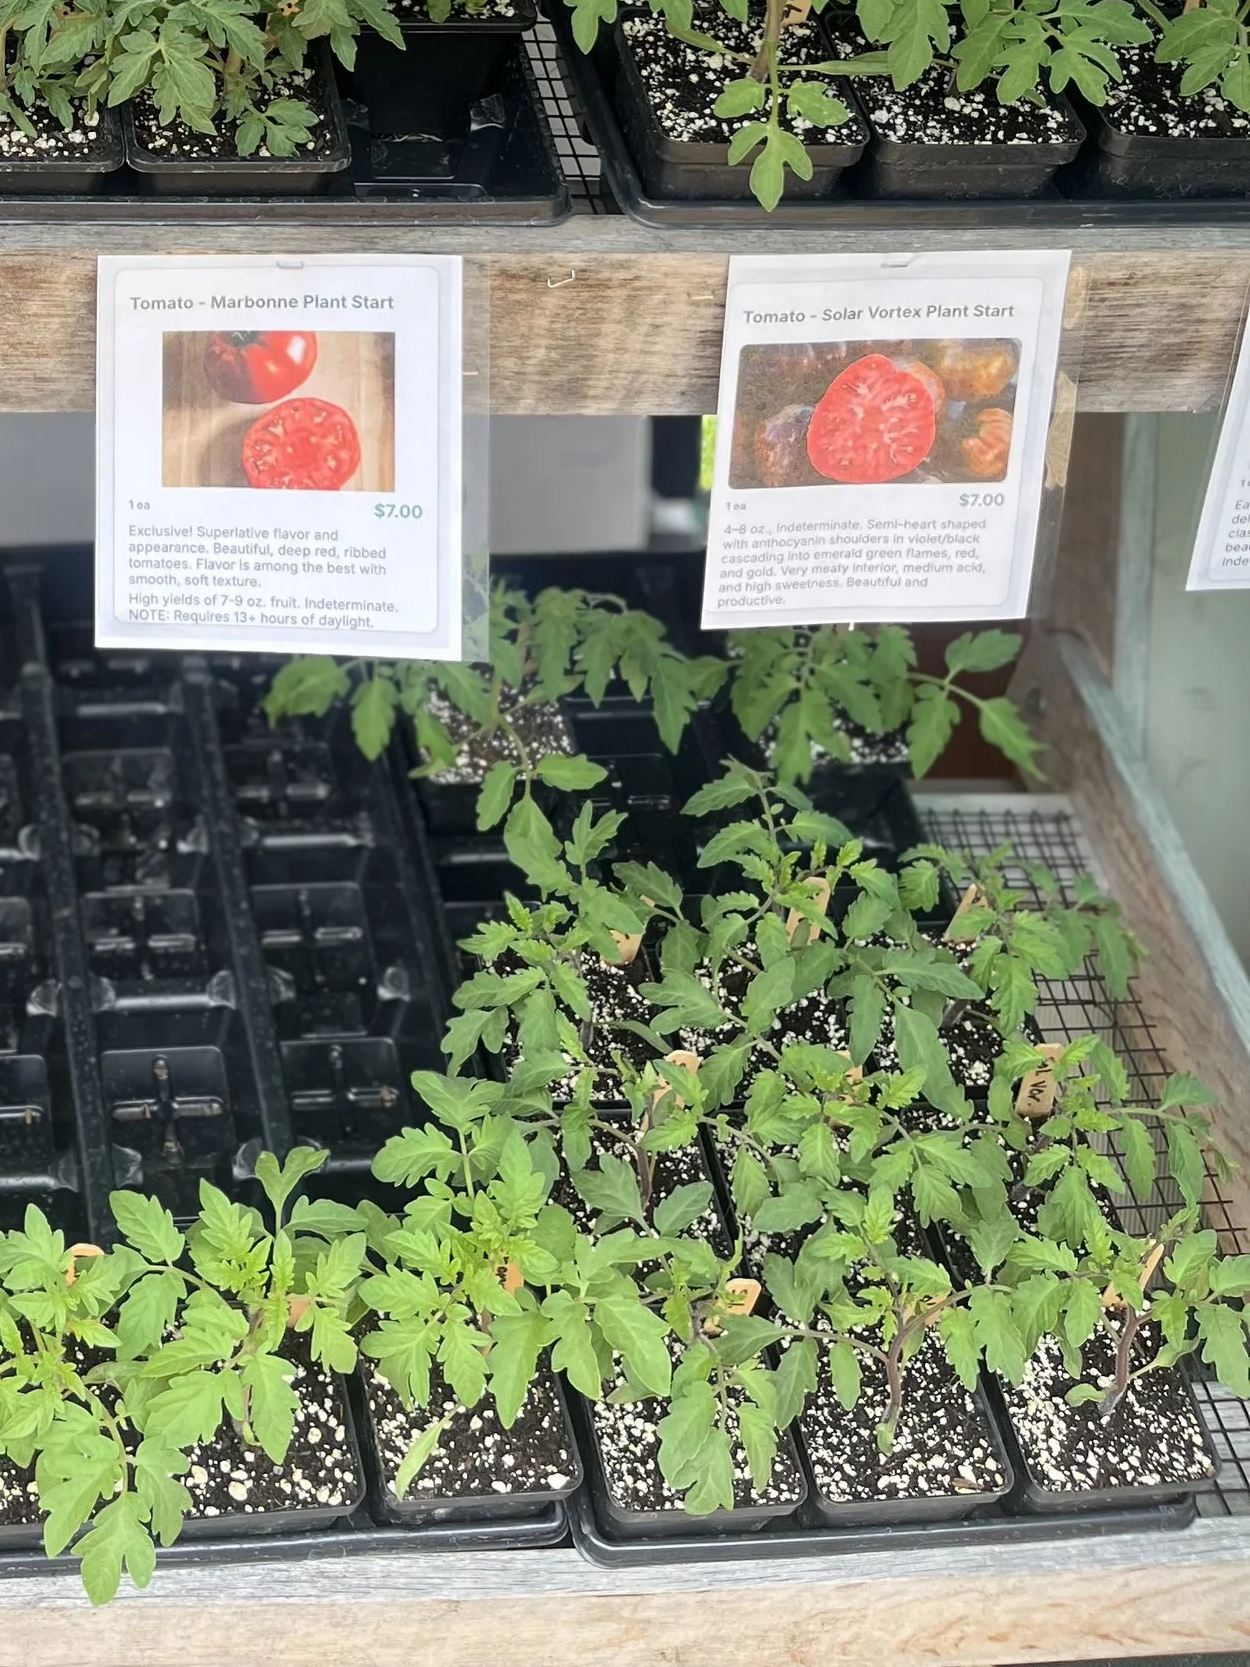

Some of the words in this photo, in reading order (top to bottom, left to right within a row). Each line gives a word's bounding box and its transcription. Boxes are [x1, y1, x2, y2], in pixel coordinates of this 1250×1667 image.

[129, 297, 193, 310] Tomato
[210, 295, 298, 308] Marbonne
[303, 294, 347, 308] Plant
[351, 294, 394, 309] Start
[743, 310, 805, 323] Tomato
[821, 307, 863, 321] Solar
[868, 306, 921, 318] Vortex
[926, 304, 969, 318] Plant
[973, 304, 1014, 317] Start
[136, 501, 150, 509] ea
[958, 492, 1005, 508] $7.00
[373, 502, 423, 519] $7.00
[128, 524, 192, 537] Exclusive!
[196, 525, 269, 540] Superlative
[272, 527, 310, 540] flavor
[313, 529, 338, 541] and
[776, 519, 862, 532] Indeterminate.
[866, 518, 936, 529] Semi-heart
[940, 518, 986, 532] shaped
[722, 538, 748, 549] with
[751, 535, 825, 549] anthocyanin
[828, 533, 889, 545] shoulders
[893, 533, 904, 544] in
[907, 533, 980, 545] violet/black
[128, 543, 209, 555] appearance.
[213, 542, 273, 557] Beautiful,
[277, 543, 311, 559] deep
[314, 546, 339, 559] red,
[344, 545, 386, 559] ribbed
[721, 551, 784, 564] cascading
[787, 550, 810, 561] into
[813, 548, 862, 560] emerald
[865, 549, 902, 560] green
[906, 547, 951, 560] flames,
[955, 547, 979, 560] red,
[128, 557, 191, 569] tomatoes.
[196, 557, 236, 570] Flavor
[239, 558, 250, 570] is
[253, 561, 298, 575] among
[301, 561, 323, 573] the
[326, 561, 355, 574] best
[358, 563, 386, 575] with
[719, 567, 743, 578] and
[746, 566, 776, 580] gold.
[780, 565, 808, 577] Very
[811, 563, 849, 575] meaty
[852, 562, 898, 574] interior,
[902, 562, 953, 573] medium
[956, 561, 985, 574] acid,
[128, 592, 158, 607] High
[162, 593, 200, 607] yields
[203, 594, 217, 606] of
[246, 597, 266, 607] oz.
[269, 596, 300, 608] fruit.
[304, 597, 398, 612] Indeterminate.
[717, 594, 785, 609] productive.
[128, 608, 169, 622] NOTE:
[173, 609, 229, 625] Requires
[233, 611, 258, 624] 13+
[260, 612, 297, 625] hours
[301, 613, 314, 626] of
[318, 614, 374, 630] daylight.
